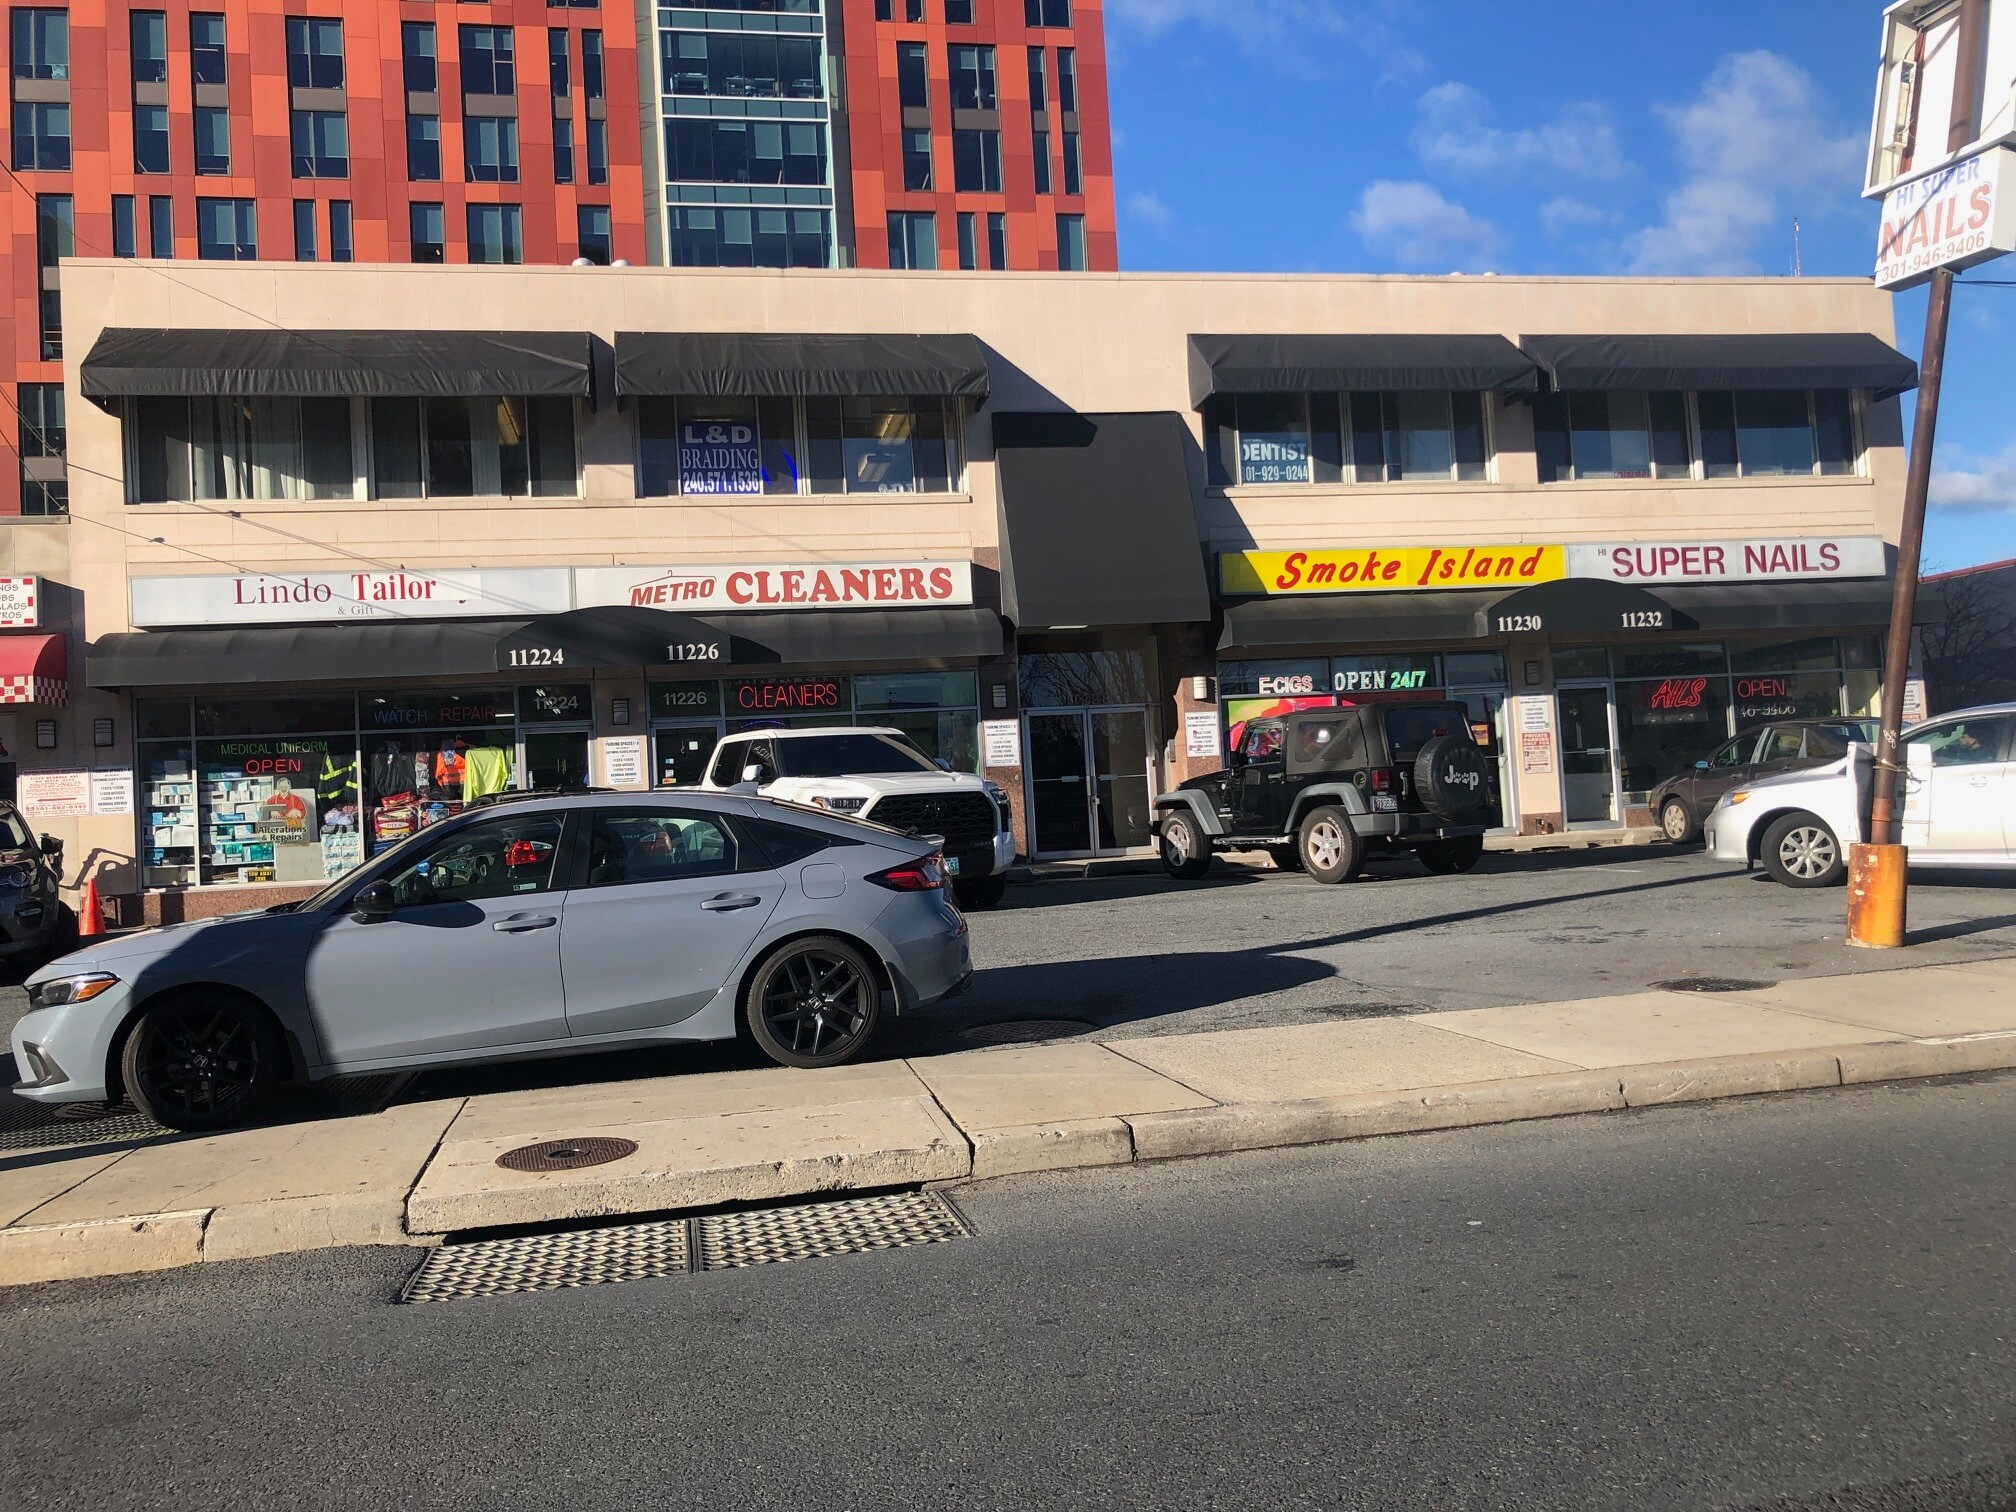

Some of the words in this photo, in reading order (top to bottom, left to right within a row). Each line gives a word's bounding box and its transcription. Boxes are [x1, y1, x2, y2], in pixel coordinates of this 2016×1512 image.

[1895, 184, 1914, 210] HI
[1921, 157, 1980, 201] SUPER
[1880, 181, 1992, 263] NAILS
[1881, 231, 1985, 283] 301-946-9406
[684, 424, 752, 444] L&D
[681, 448, 759, 469] BRAIDING
[1242, 465, 1309, 481] 01-929-0244
[1276, 551, 1401, 590] Smoke
[1418, 546, 1544, 586] Island
[1597, 548, 1607, 556] HI
[1612, 546, 1726, 577] SUPER
[1745, 542, 1841, 574] NAILS
[233, 578, 332, 605] Lindo
[351, 573, 437, 601] Tailor
[630, 579, 715, 607] METRO
[725, 567, 953, 605] CLEANERS
[337, 606, 346, 615] &
[351, 604, 375, 615] Gift
[1497, 614, 1542, 632] 11230
[1620, 611, 1663, 628] 11232
[508, 648, 564, 667] 11224
[667, 643, 719, 661] 11226
[1334, 671, 1386, 691] OPEN
[1390, 670, 1427, 689] 24/7
[1737, 679, 1786, 698] OPEN
[663, 691, 708, 705] 11226
[739, 683, 837, 708] CLEANERS
[374, 709, 428, 724] WATCH
[440, 705, 496, 722] REPAIR
[221, 742, 271, 755] MEDICAL
[276, 742, 328, 754] UNIFORM
[246, 759, 301, 774] OPEN
[258, 826, 307, 834] Alterations
[270, 833, 303, 841] Repairs
